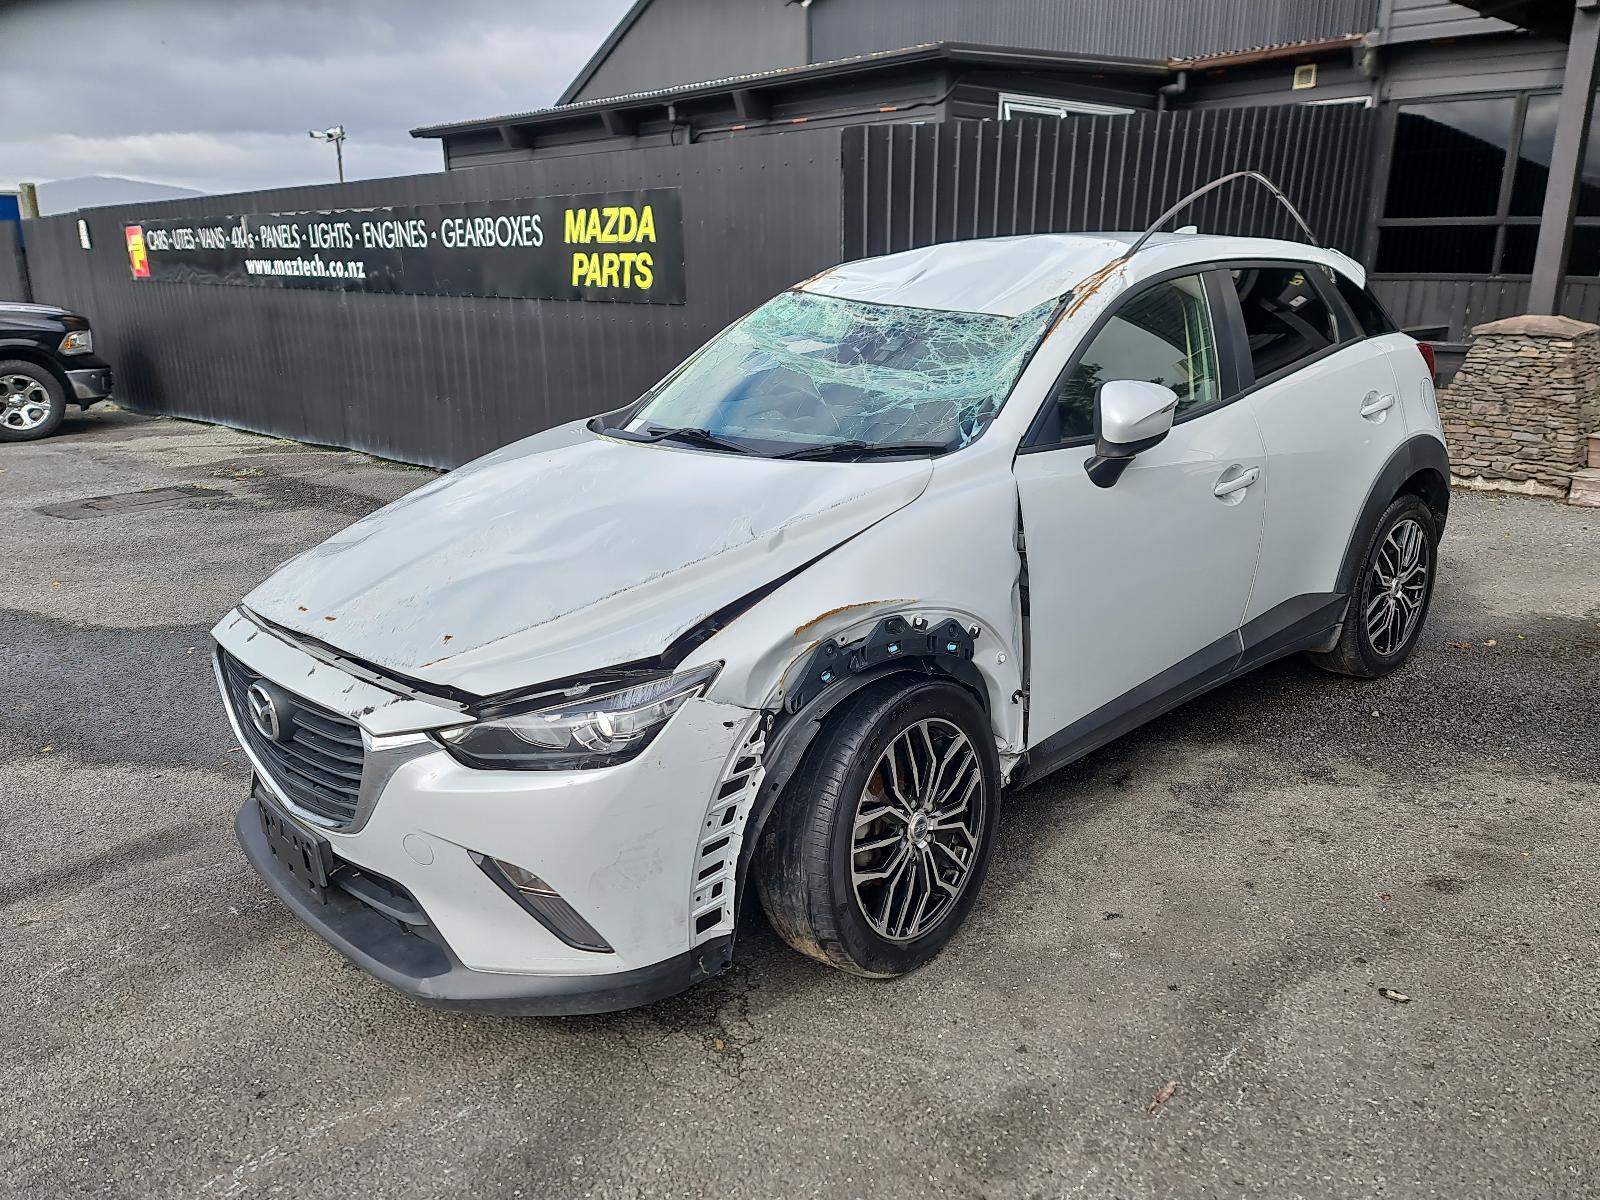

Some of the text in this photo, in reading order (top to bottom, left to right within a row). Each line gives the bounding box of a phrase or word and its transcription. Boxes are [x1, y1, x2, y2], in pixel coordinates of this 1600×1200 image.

[146, 229, 170, 250] CARS
[171, 228, 196, 250] UTES
[198, 226, 226, 249] VANS
[260, 223, 300, 249] PANELS
[308, 222, 353, 249] LIGHTS
[362, 219, 428, 249] ENGINES
[441, 214, 544, 248] GEARBOXES
[563, 205, 656, 244] MAZDA
[244, 253, 366, 279] www.maztech.co.nz
[571, 252, 654, 289] PARTS
